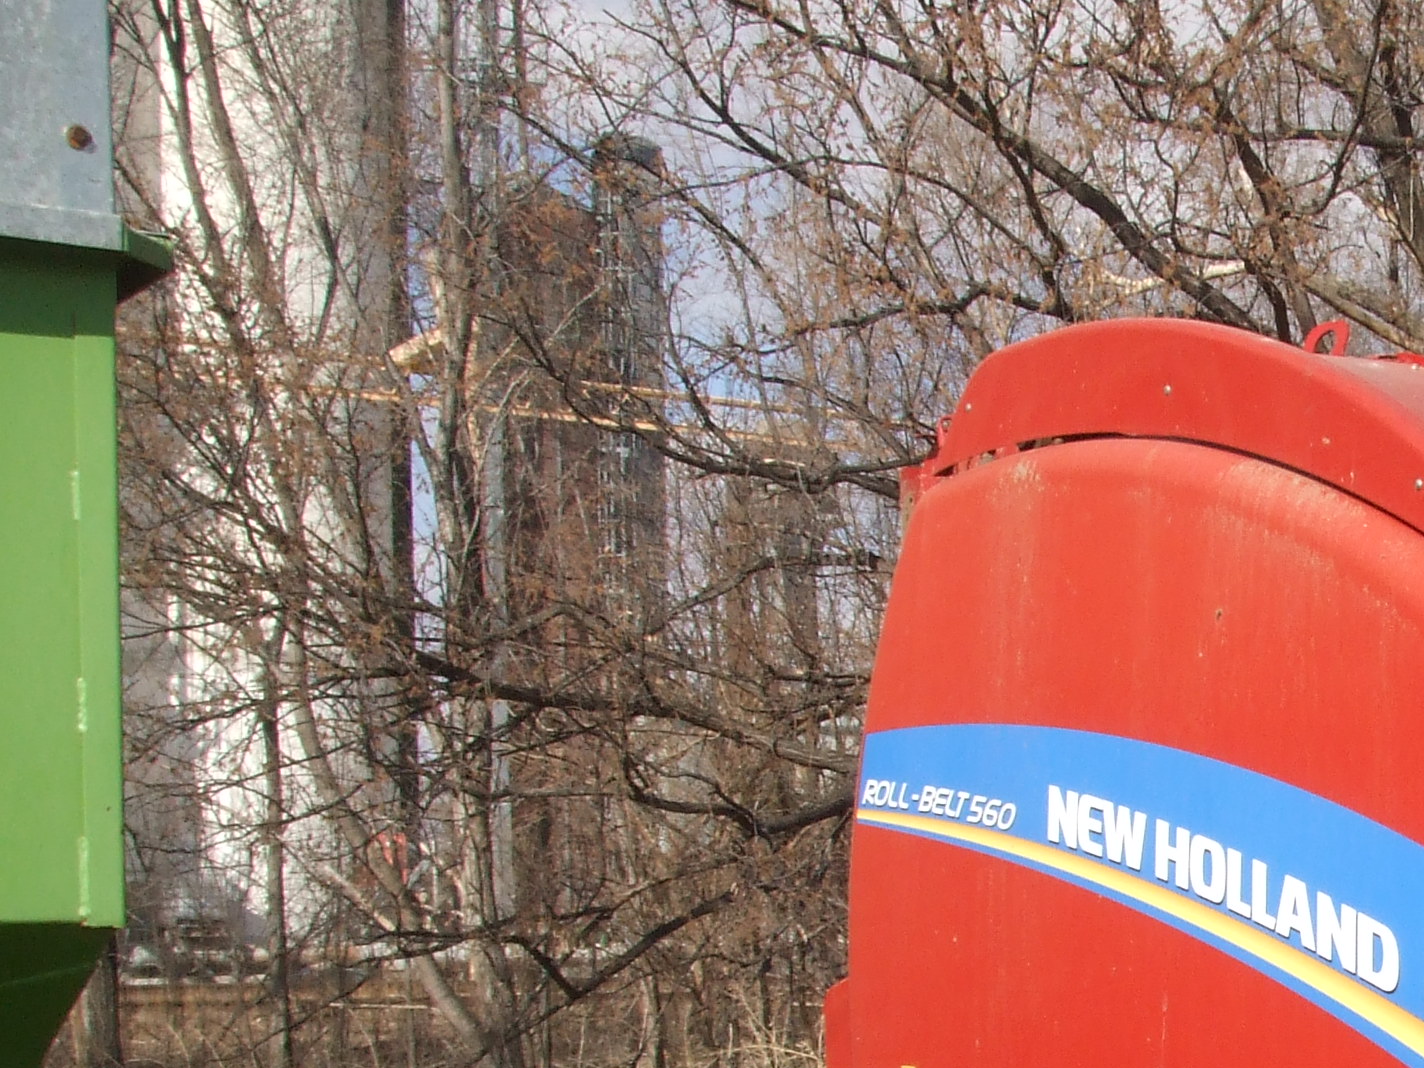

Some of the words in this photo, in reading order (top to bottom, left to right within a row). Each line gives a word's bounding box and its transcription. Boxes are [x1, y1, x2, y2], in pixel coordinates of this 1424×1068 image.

[861, 778, 970, 819] ROLL-BELT
[968, 796, 1017, 831] 560
[1046, 784, 1147, 872] NEW
[1154, 818, 1400, 994] HOLLAND
